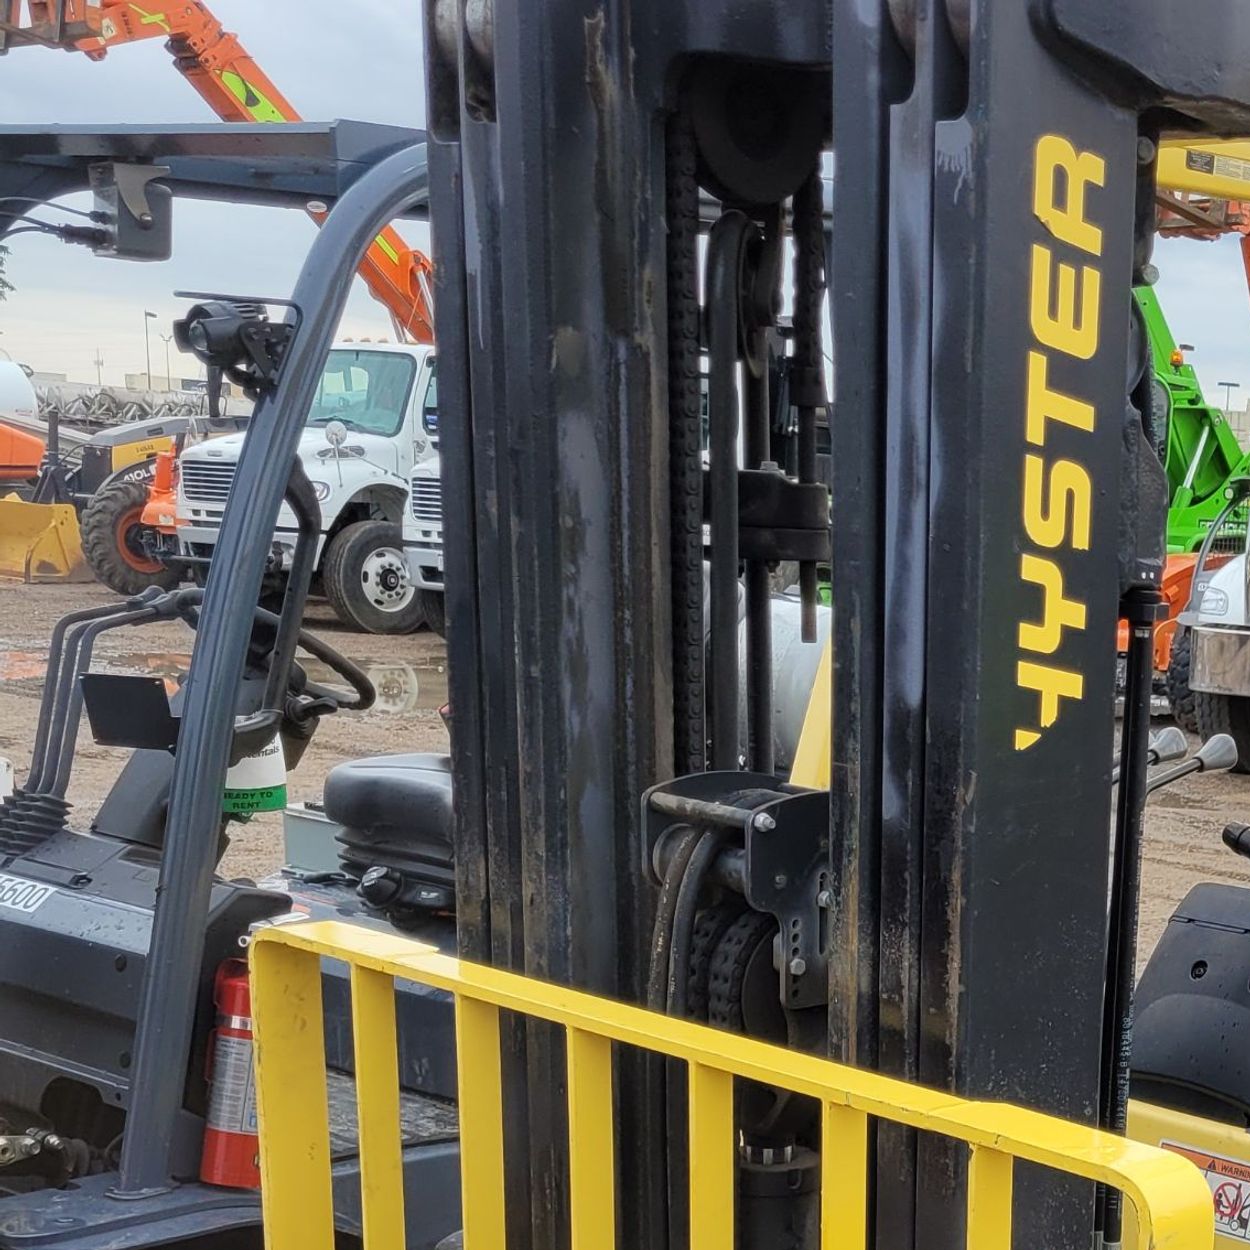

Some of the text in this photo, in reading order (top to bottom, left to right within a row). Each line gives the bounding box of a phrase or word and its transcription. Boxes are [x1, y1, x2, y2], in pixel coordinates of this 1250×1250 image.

[1014, 133, 1105, 751] HYSTER
[261, 790, 274, 799] TO
[232, 801, 261, 810] RENT
